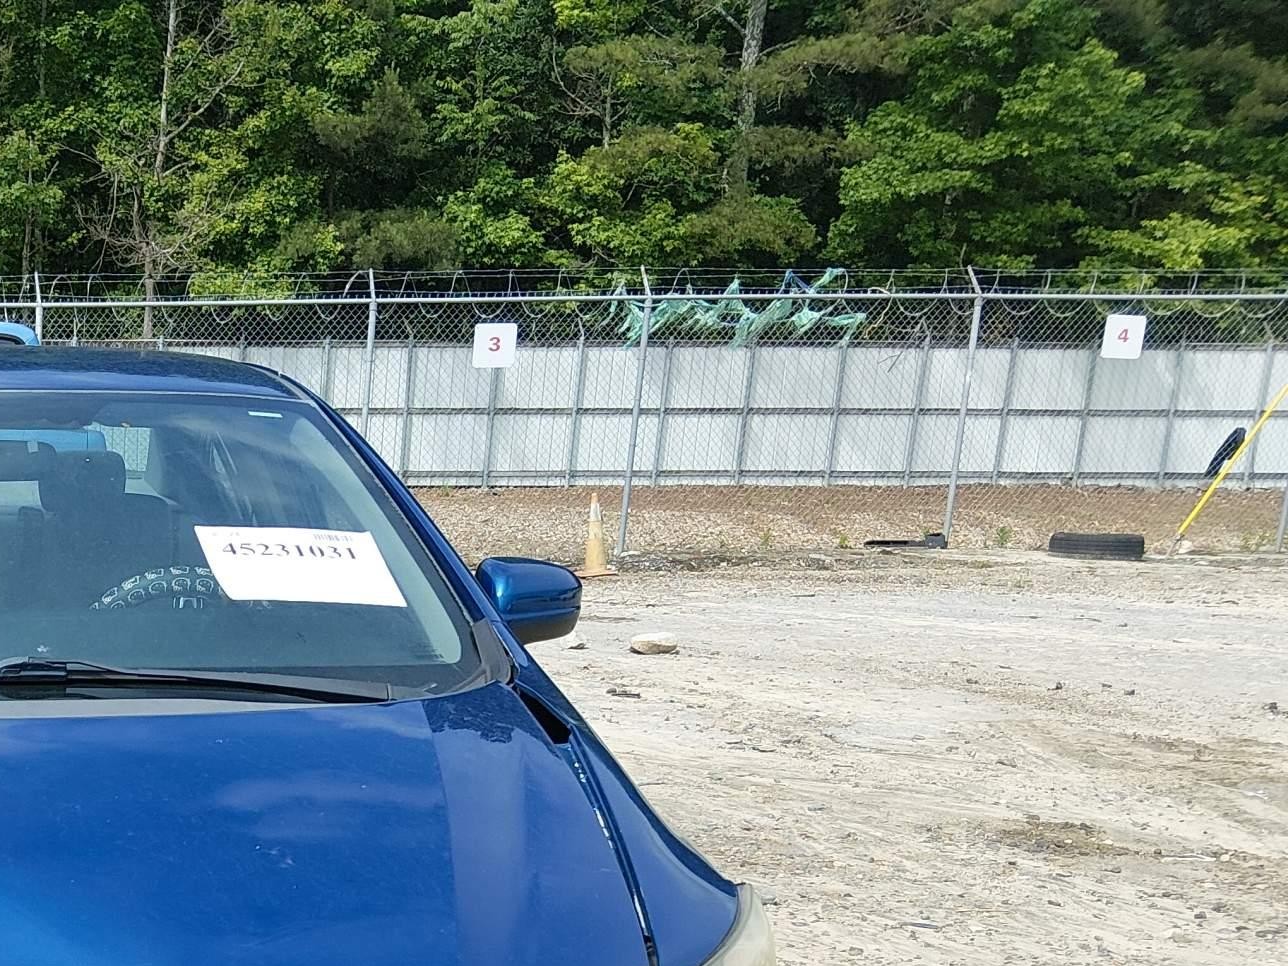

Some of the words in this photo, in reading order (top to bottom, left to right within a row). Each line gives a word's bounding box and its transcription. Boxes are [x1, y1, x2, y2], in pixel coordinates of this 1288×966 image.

[1117, 328, 1130, 343] 4
[488, 336, 501, 352] 3
[221, 541, 357, 560] 45231031
